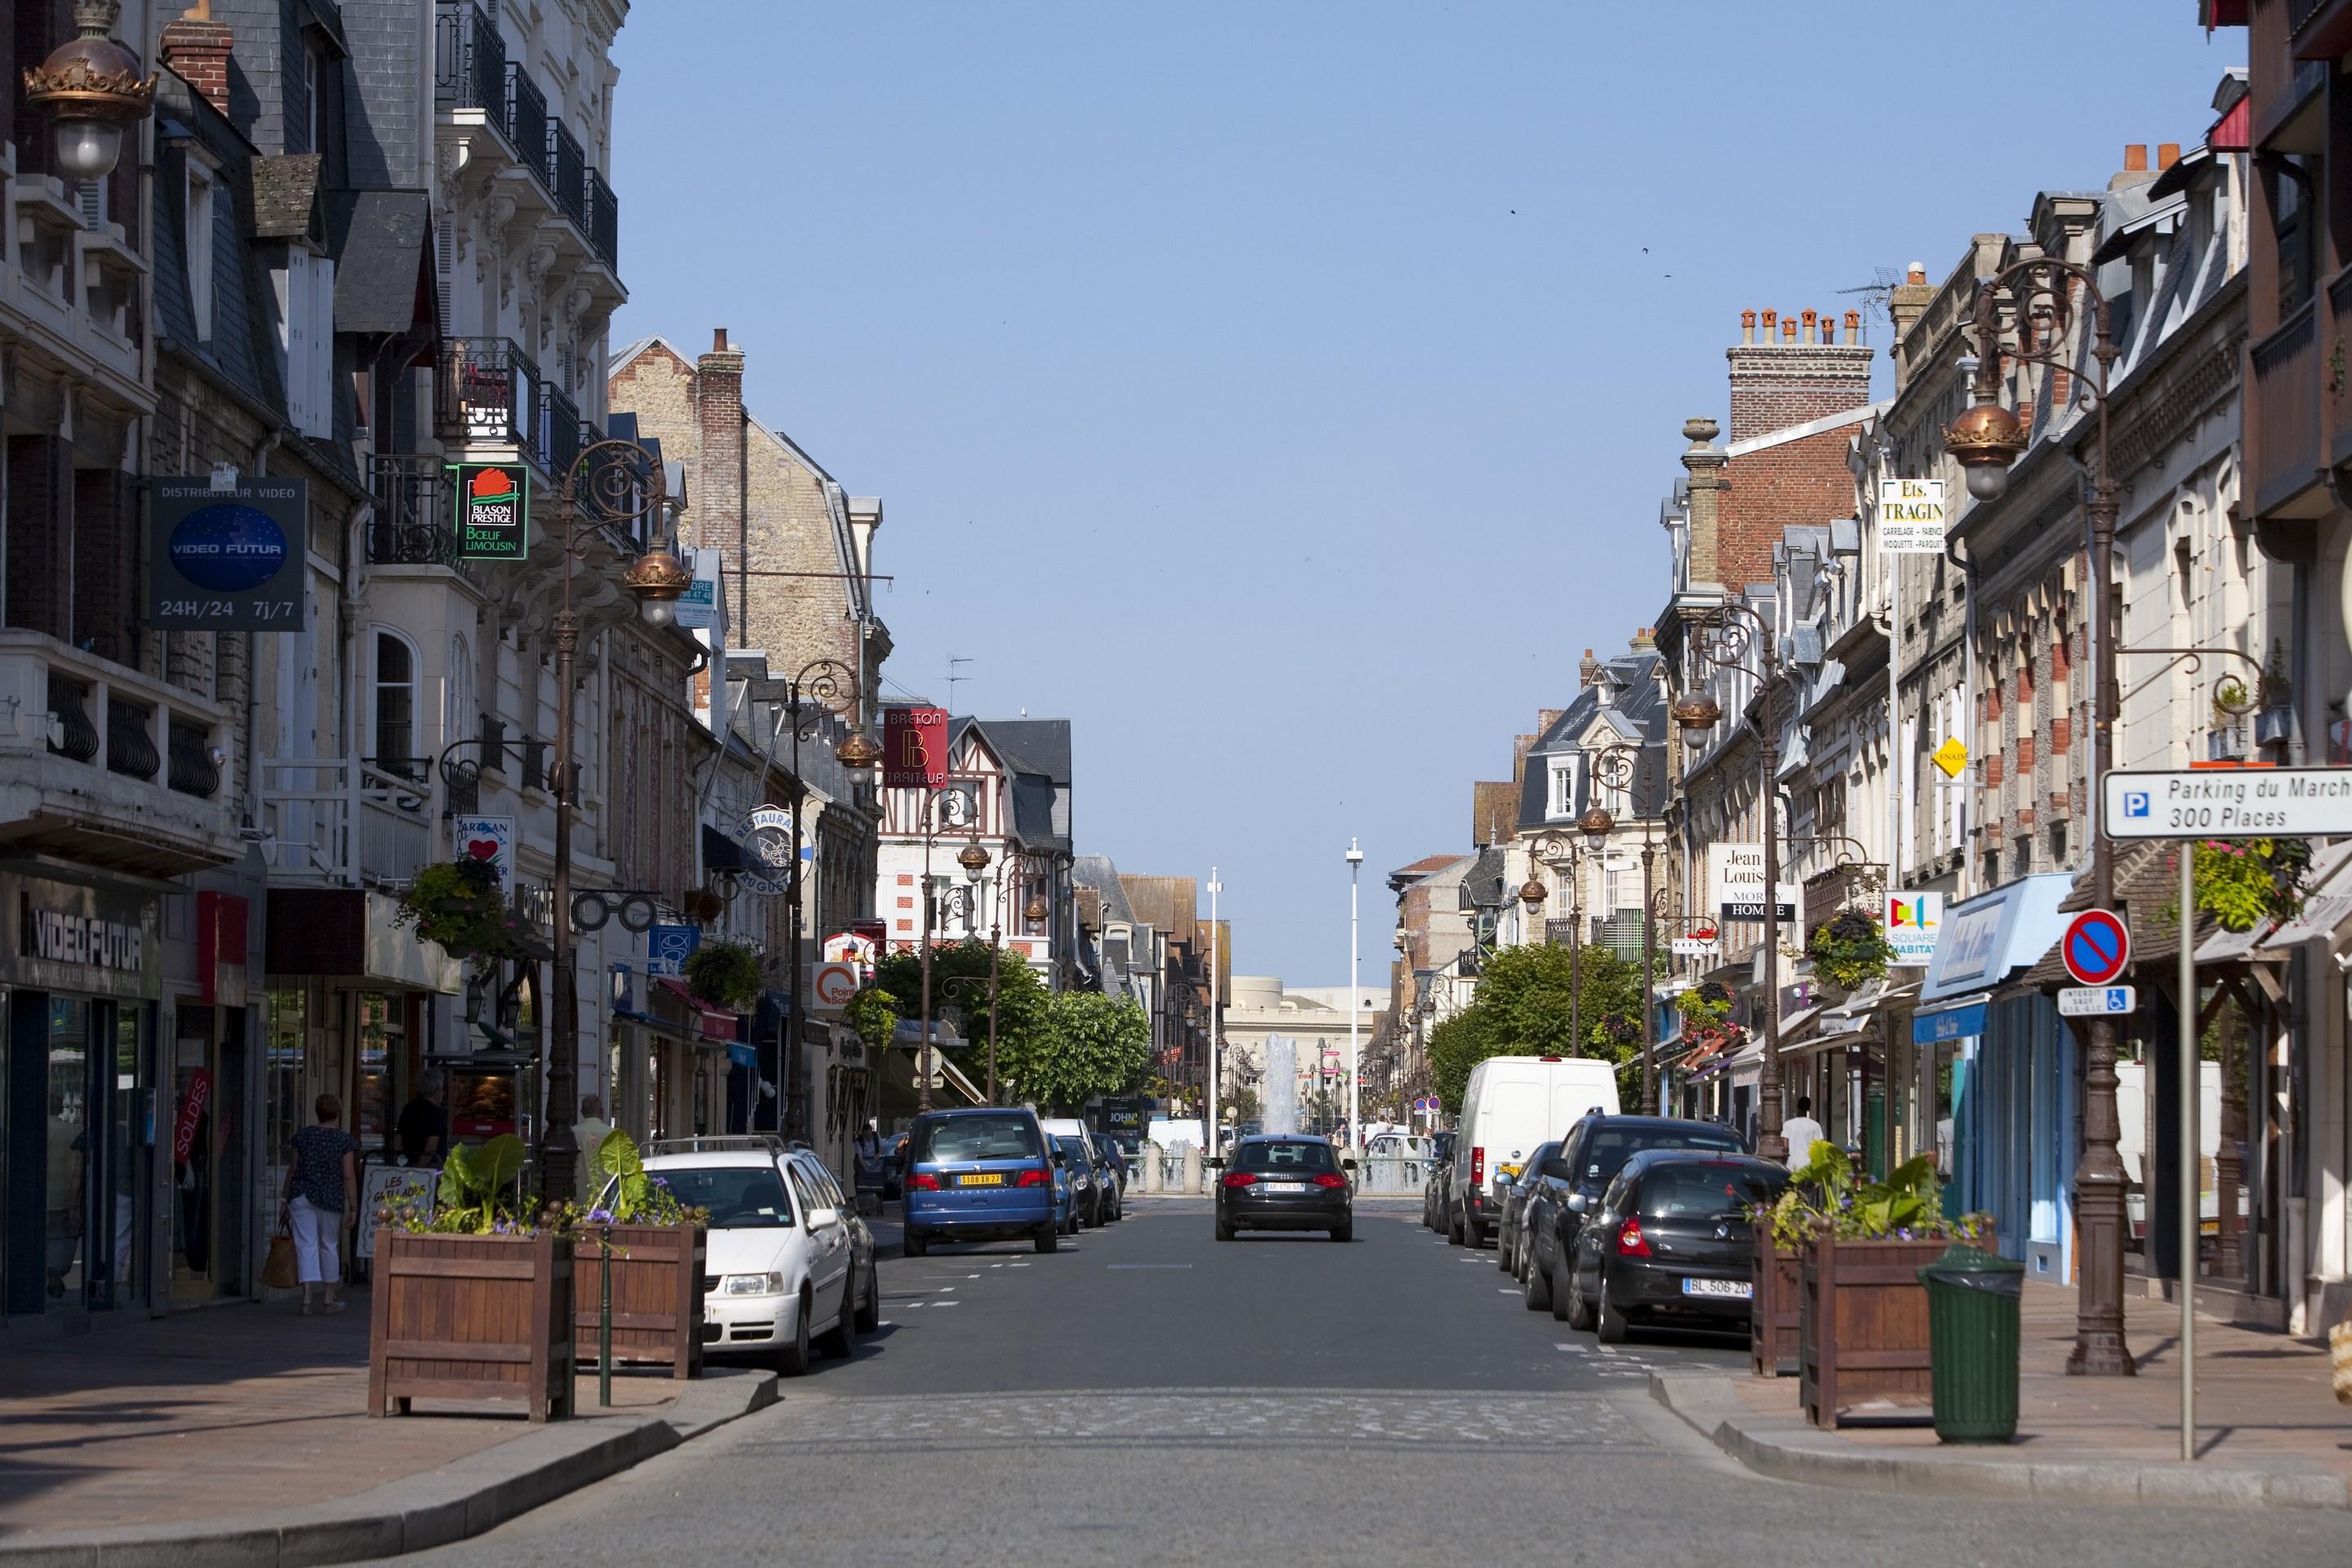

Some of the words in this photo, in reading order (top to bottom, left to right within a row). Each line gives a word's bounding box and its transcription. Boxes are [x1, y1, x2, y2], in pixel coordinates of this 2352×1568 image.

[162, 488, 252, 498] DISTRIBUTEUR
[258, 488, 295, 498] VIDEO
[1902, 481, 1927, 497] Ets.
[473, 506, 510, 514] BLASON
[1882, 503, 1943, 520] TRAGIN
[471, 514, 512, 523] PRESTIGE
[173, 545, 219, 554] VIDEO
[225, 545, 281, 554] FUTUR
[466, 541, 516, 550] LIMOUSIN
[160, 601, 234, 620] 24H/24
[253, 602, 293, 620] 7j/7
[891, 714, 942, 724] BRETON
[902, 730, 929, 767] B
[887, 772, 944, 783] TRAITEUR
[2168, 778, 2247, 804] Parking
[2256, 778, 2278, 797] du
[2127, 795, 2147, 816] P
[2169, 807, 2212, 828] 300
[2221, 805, 2287, 827] Places
[736, 813, 804, 838] RESTAURA
[1726, 850, 1760, 866] Jean
[1734, 892, 1784, 902] MORY
[1732, 905, 1785, 915] HOME
[35, 909, 87, 964] VIDEO
[89, 918, 143, 972] FUTUR
[1891, 933, 1936, 943] SQUARE
[832, 987, 855, 996] Point
[2065, 989, 2101, 997] INTERDIT
[177, 1078, 207, 1156] SOLDES
[385, 1177, 403, 1188] LES
[962, 1176, 979, 1184] 3108
[991, 1175, 1000, 1183] 27
